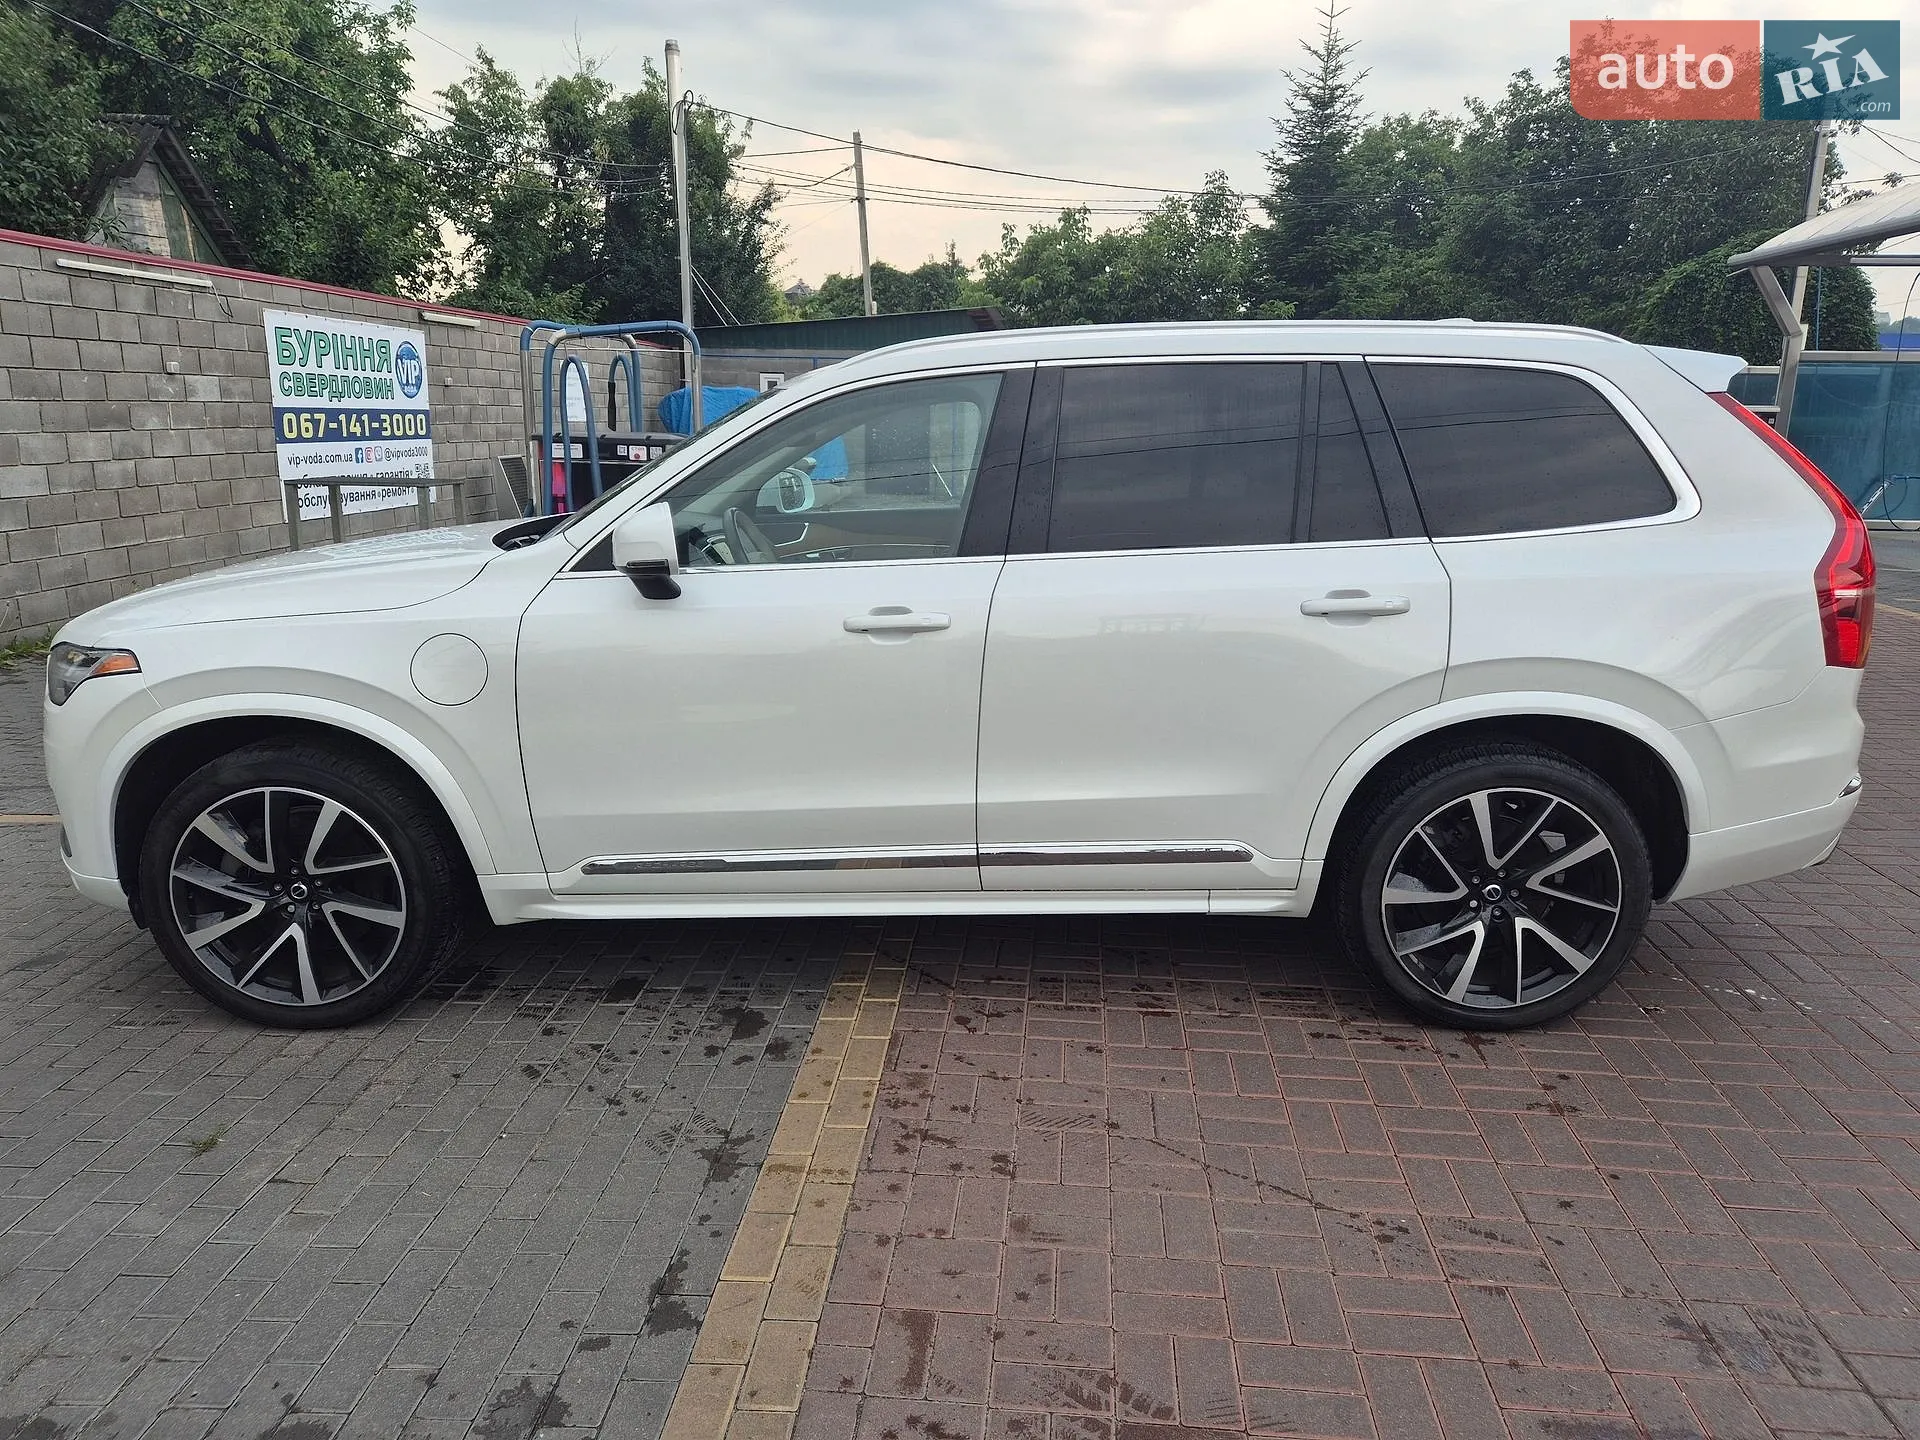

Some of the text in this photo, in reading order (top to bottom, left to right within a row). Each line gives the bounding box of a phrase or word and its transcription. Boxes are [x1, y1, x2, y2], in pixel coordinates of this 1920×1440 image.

[274, 326, 393, 374] БУРІННЯ
[397, 358, 420, 385] VIP
[279, 371, 395, 402] СВЕРДЛОВИН
[282, 412, 427, 439] 067-141-3000
[287, 446, 428, 468] vip-voda.com.ua @vipvoda3000
[381, 486, 410, 501] ремонт
